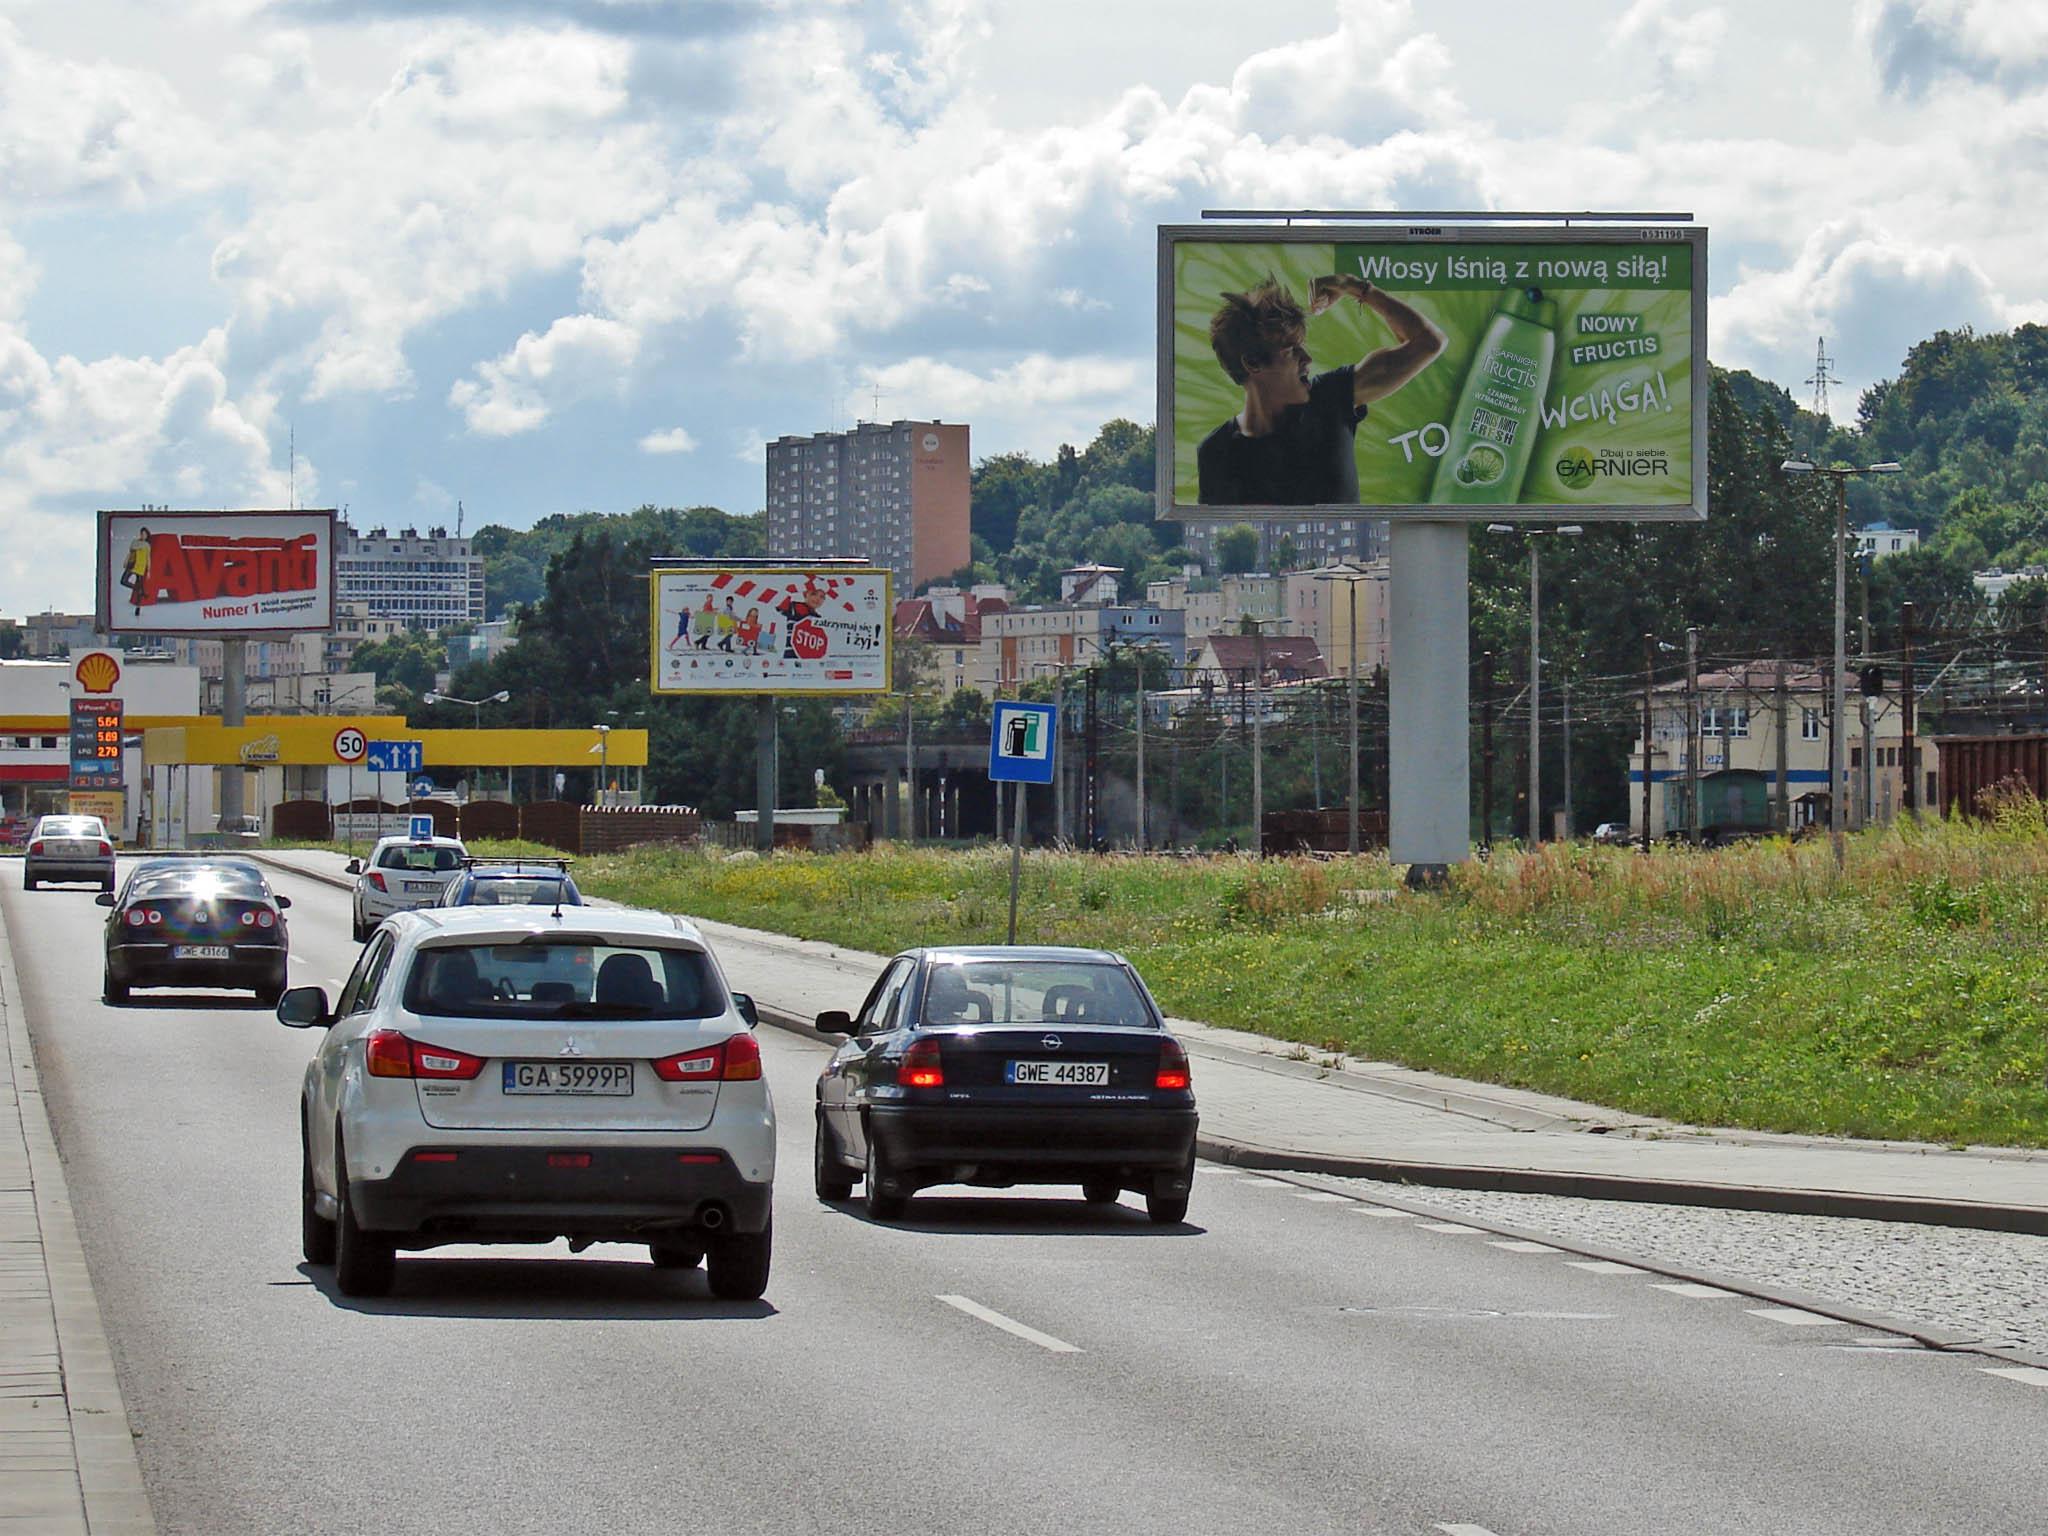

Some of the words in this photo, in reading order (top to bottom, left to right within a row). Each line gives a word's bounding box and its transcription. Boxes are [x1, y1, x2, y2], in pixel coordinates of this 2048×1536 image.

[1358, 256, 1438, 283] Włosy
[1447, 256, 1508, 283] lśnią
[1516, 261, 1529, 278] z
[1538, 260, 1608, 283] nową
[1616, 255, 1667, 283] siłą!
[1581, 316, 1638, 333] NOWY
[1573, 337, 1658, 364] FRUCTIS
[1539, 371, 1672, 430] WCIĄGA!
[1388, 422, 1450, 463] TO
[1470, 422, 1515, 445] FRESH
[1600, 448, 1624, 458] Dbaj
[1636, 449, 1669, 457] siebie.
[129, 533, 317, 606] Avanti
[202, 605, 248, 620] Numer
[252, 602, 259, 614] 1
[814, 619, 857, 631] zatrzymaj
[796, 629, 825, 651] STOP
[340, 737, 362, 753] 50
[417, 820, 427, 834] L
[518, 1066, 551, 1087] GA
[559, 1066, 628, 1088] 5999P
[1016, 1064, 1049, 1082] GWE
[1055, 1065, 1106, 1083] 44387
